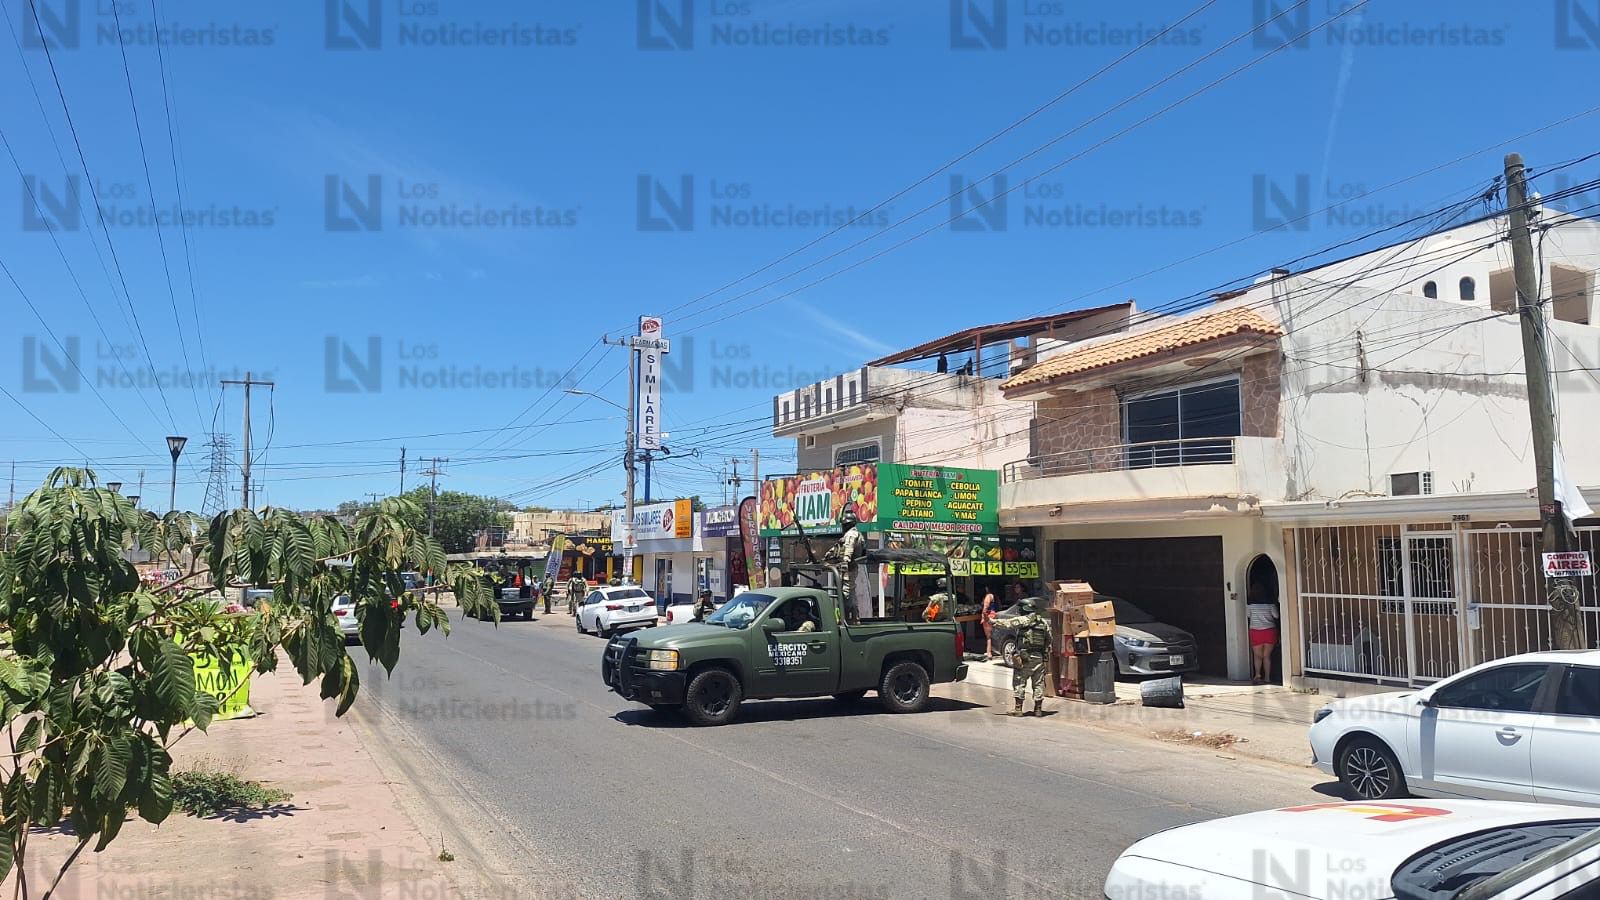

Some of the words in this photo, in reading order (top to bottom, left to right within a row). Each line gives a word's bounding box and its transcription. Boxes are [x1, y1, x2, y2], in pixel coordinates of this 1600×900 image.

[645, 354, 656, 445] SIMILARES
[904, 479, 934, 489] TOMATE
[950, 482, 980, 491] CEBOLLA
[895, 489, 914, 498] PAPA
[914, 490, 943, 499] BLANCA
[905, 498, 932, 508] PEPINO
[947, 502, 984, 511] AGUACATE
[902, 508, 934, 518] PLÁTANO
[960, 510, 977, 520] MÁS
[893, 521, 924, 530] CALIDAD
[930, 522, 957, 531] MEJOR
[957, 523, 983, 533] PRECIO
[744, 504, 763, 569] VERDURAS
[1548, 560, 1588, 570] AIRES
[774, 656, 802, 666] 3318351
